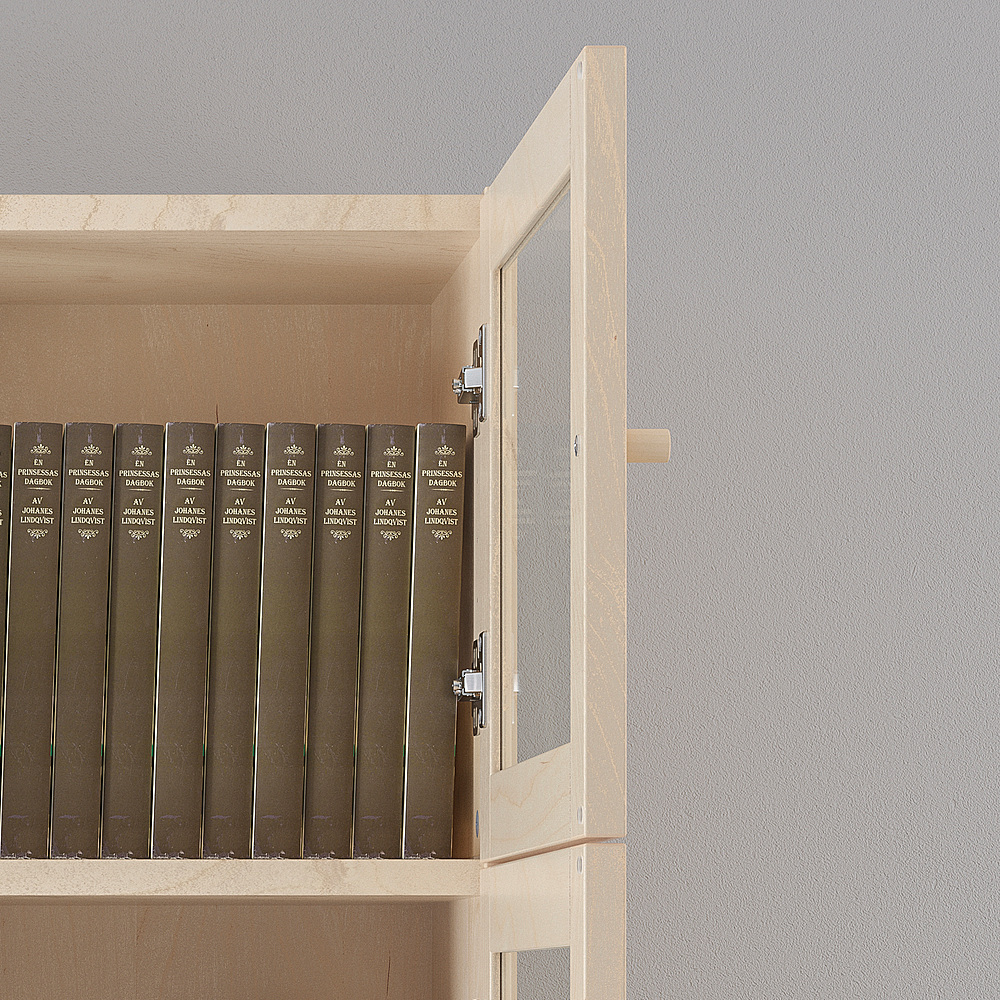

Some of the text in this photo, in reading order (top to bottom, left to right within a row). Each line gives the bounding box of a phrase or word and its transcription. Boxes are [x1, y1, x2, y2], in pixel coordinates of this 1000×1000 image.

[69, 469, 109, 478] PRINSESSAS
[221, 470, 261, 478] PRINSESSAS
[422, 470, 462, 478] PRINSESSAS
[227, 479, 255, 487] DAGBOK
[428, 479, 457, 487] DAGBOK
[73, 507, 104, 515] JOHANES
[225, 508, 256, 516] JOHANES
[426, 508, 457, 516] JOHANES
